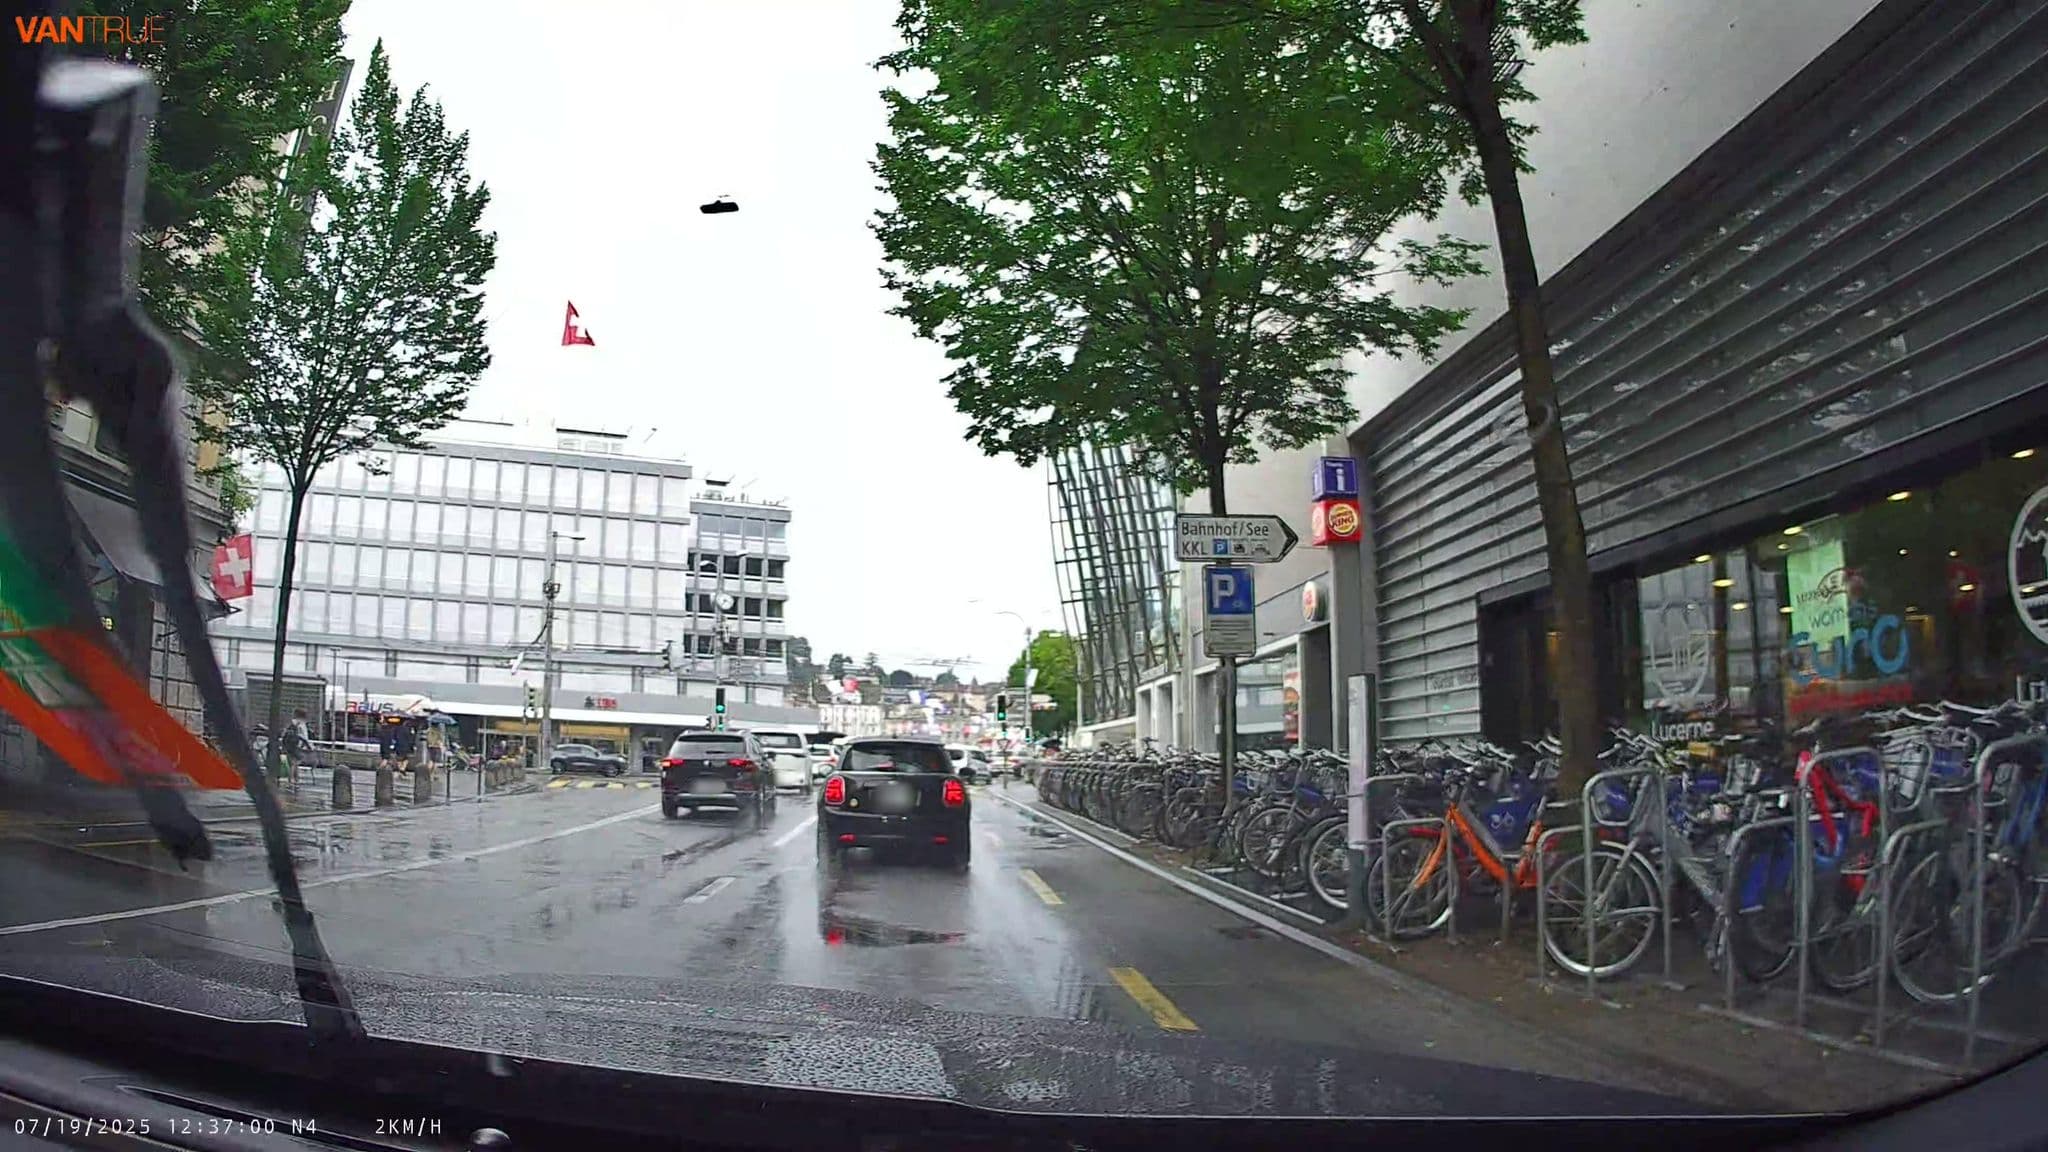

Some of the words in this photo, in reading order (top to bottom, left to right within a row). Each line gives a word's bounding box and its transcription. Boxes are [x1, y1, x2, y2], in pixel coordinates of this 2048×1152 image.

[1181, 521, 1269, 536] Bahnhof/See
[1181, 541, 1208, 555] KKL
[1211, 573, 1235, 609] P
[1651, 720, 1715, 741] Lucerne
